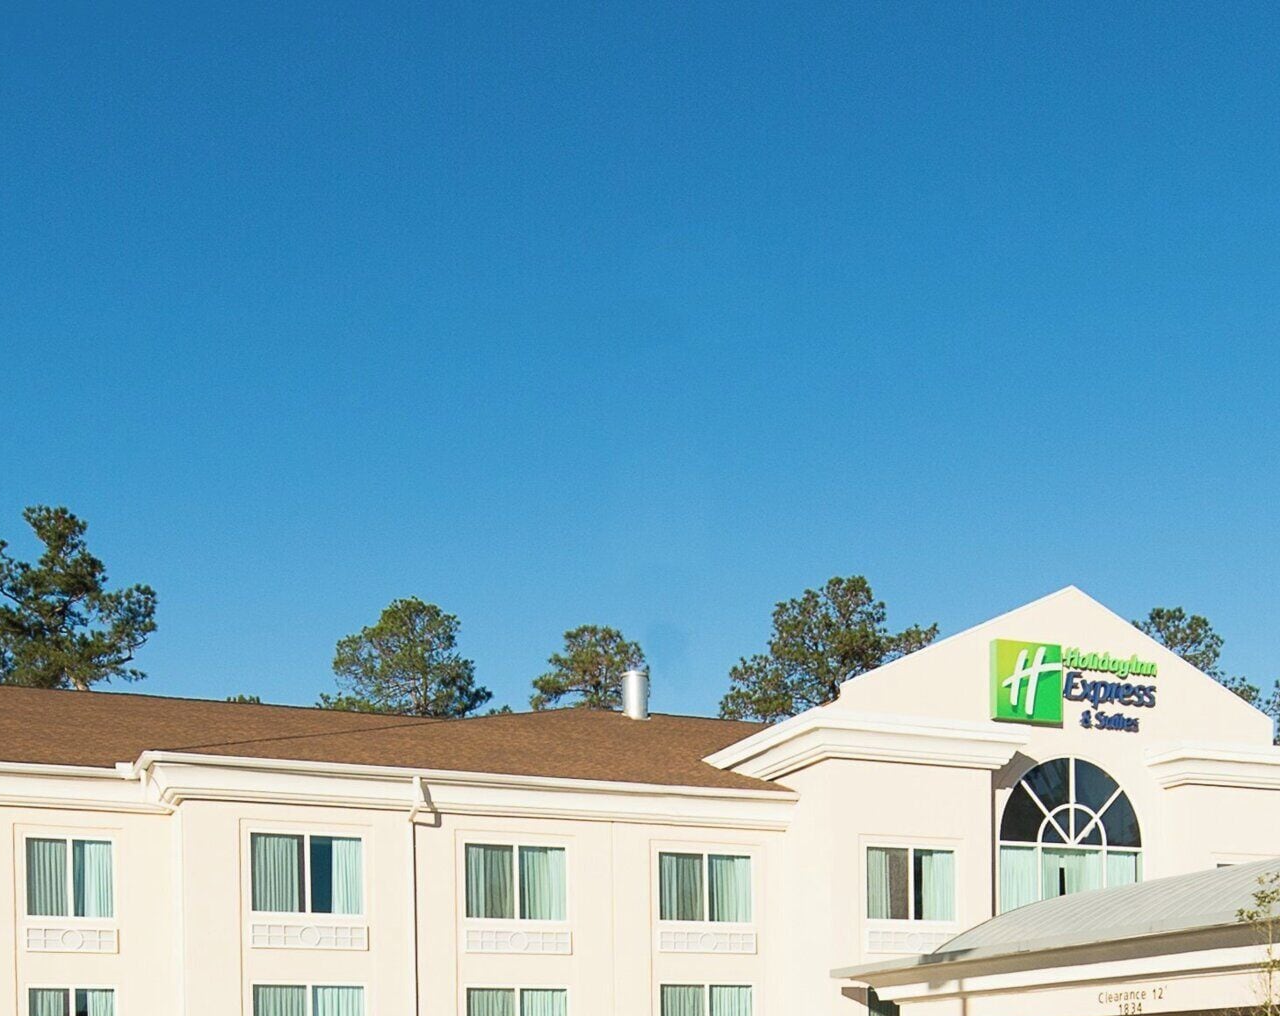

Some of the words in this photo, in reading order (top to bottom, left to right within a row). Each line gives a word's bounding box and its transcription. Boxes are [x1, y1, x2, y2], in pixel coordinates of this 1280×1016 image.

[1063, 647, 1130, 680] Holiday
[1130, 654, 1158, 677] Inn
[1002, 646, 1062, 716] H
[1063, 671, 1158, 711] Express
[1080, 710, 1093, 729] &
[1094, 711, 1140, 733] Suites
[1098, 990, 1147, 1004] Clearance
[1118, 1002, 1143, 1016] 1834
